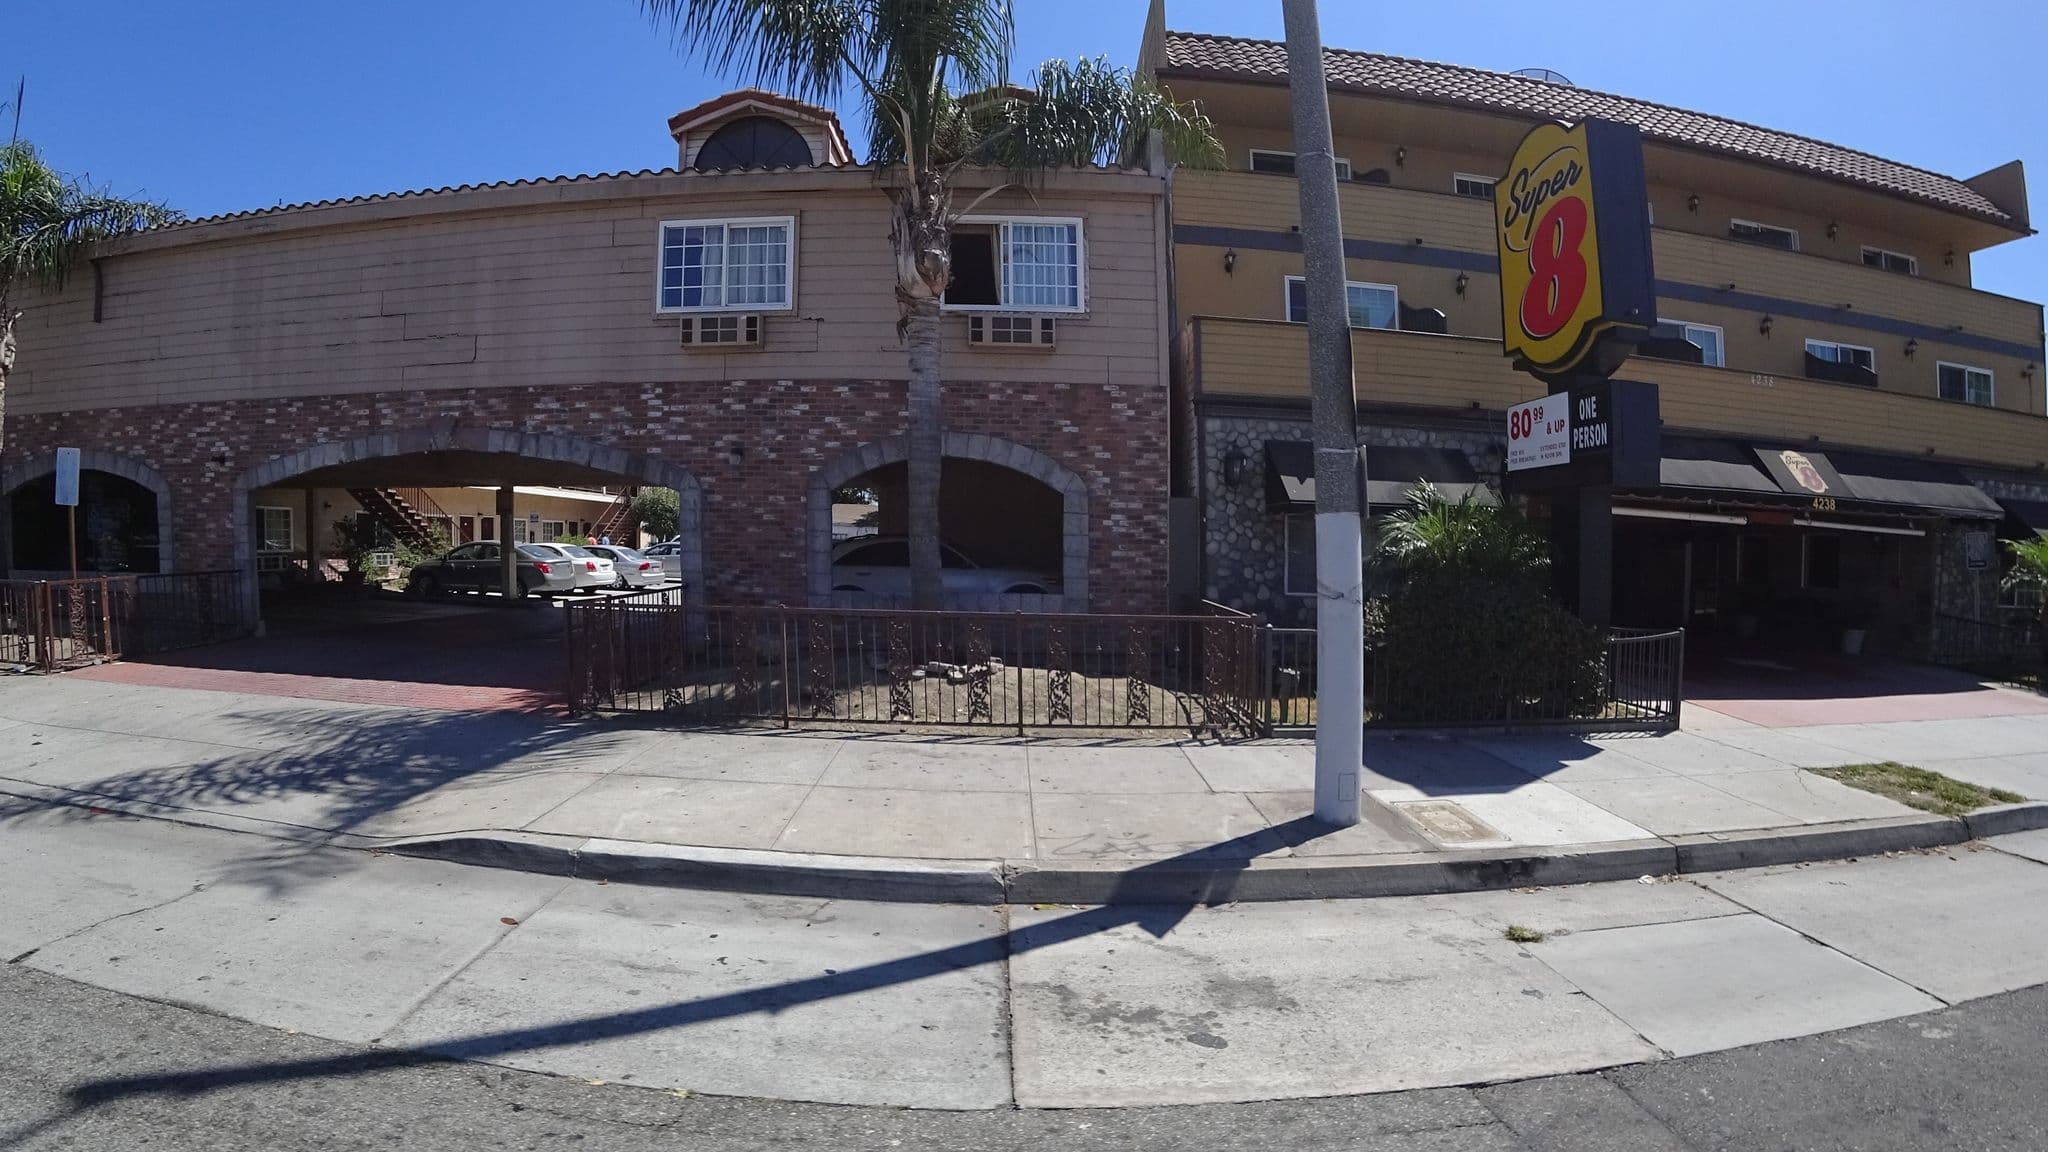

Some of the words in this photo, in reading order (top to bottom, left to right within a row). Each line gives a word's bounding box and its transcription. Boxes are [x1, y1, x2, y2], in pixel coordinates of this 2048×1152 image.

[1504, 160, 1583, 241] Super
[1519, 196, 1588, 342] 8
[1579, 396, 1597, 420] ONE
[1511, 408, 1532, 440] 80
[1533, 406, 1544, 421] 99
[1546, 422, 1552, 435] &
[1554, 419, 1565, 433] UP
[1573, 422, 1608, 449] PERSON
[1785, 455, 1810, 469] Super
[1812, 498, 1836, 510] 4238
